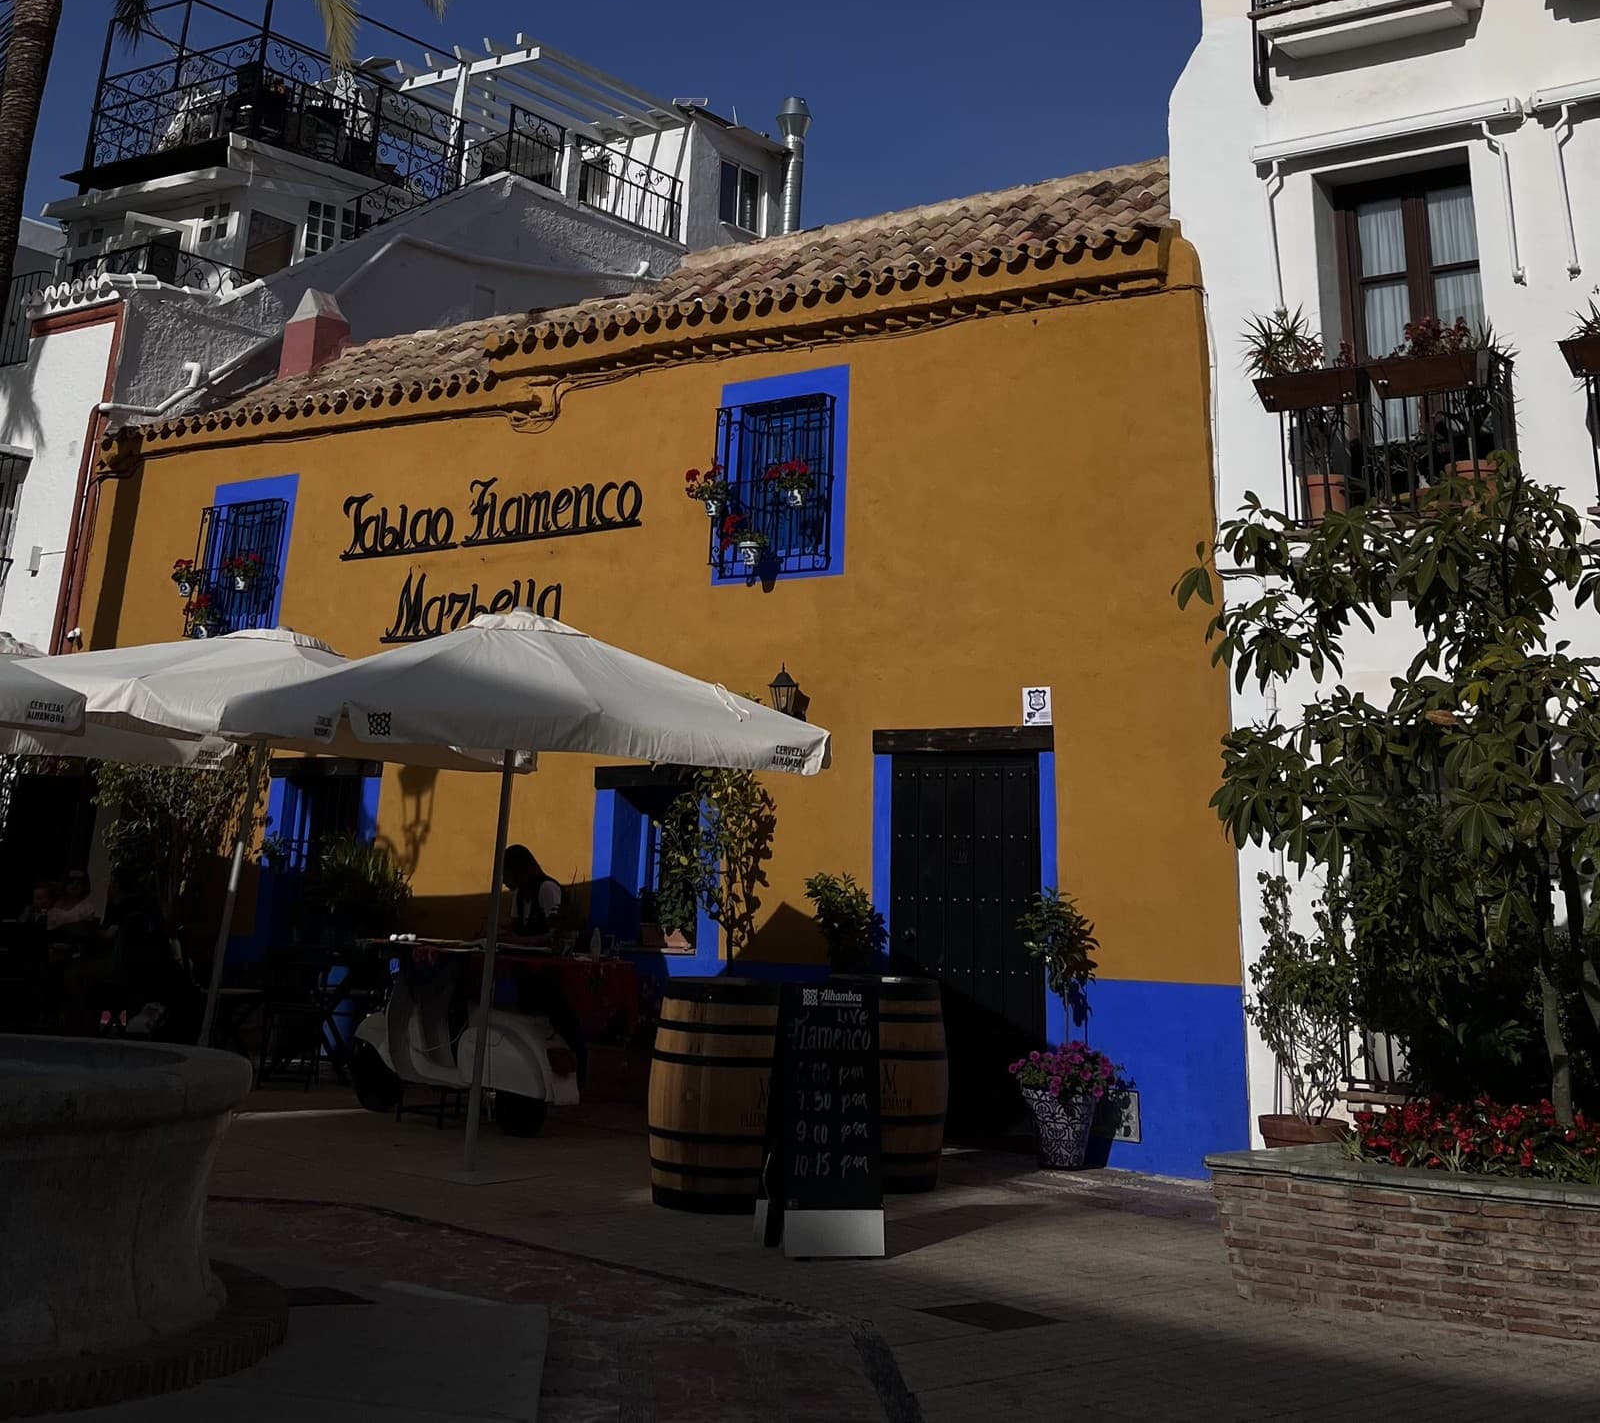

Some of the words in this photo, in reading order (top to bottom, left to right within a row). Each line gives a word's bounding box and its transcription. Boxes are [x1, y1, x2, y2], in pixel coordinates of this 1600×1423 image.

[343, 493, 454, 557] Tablao
[464, 477, 643, 541] Flamenco
[30, 700, 64, 713] CERVEZAS
[819, 989, 862, 1002] Alhambra
